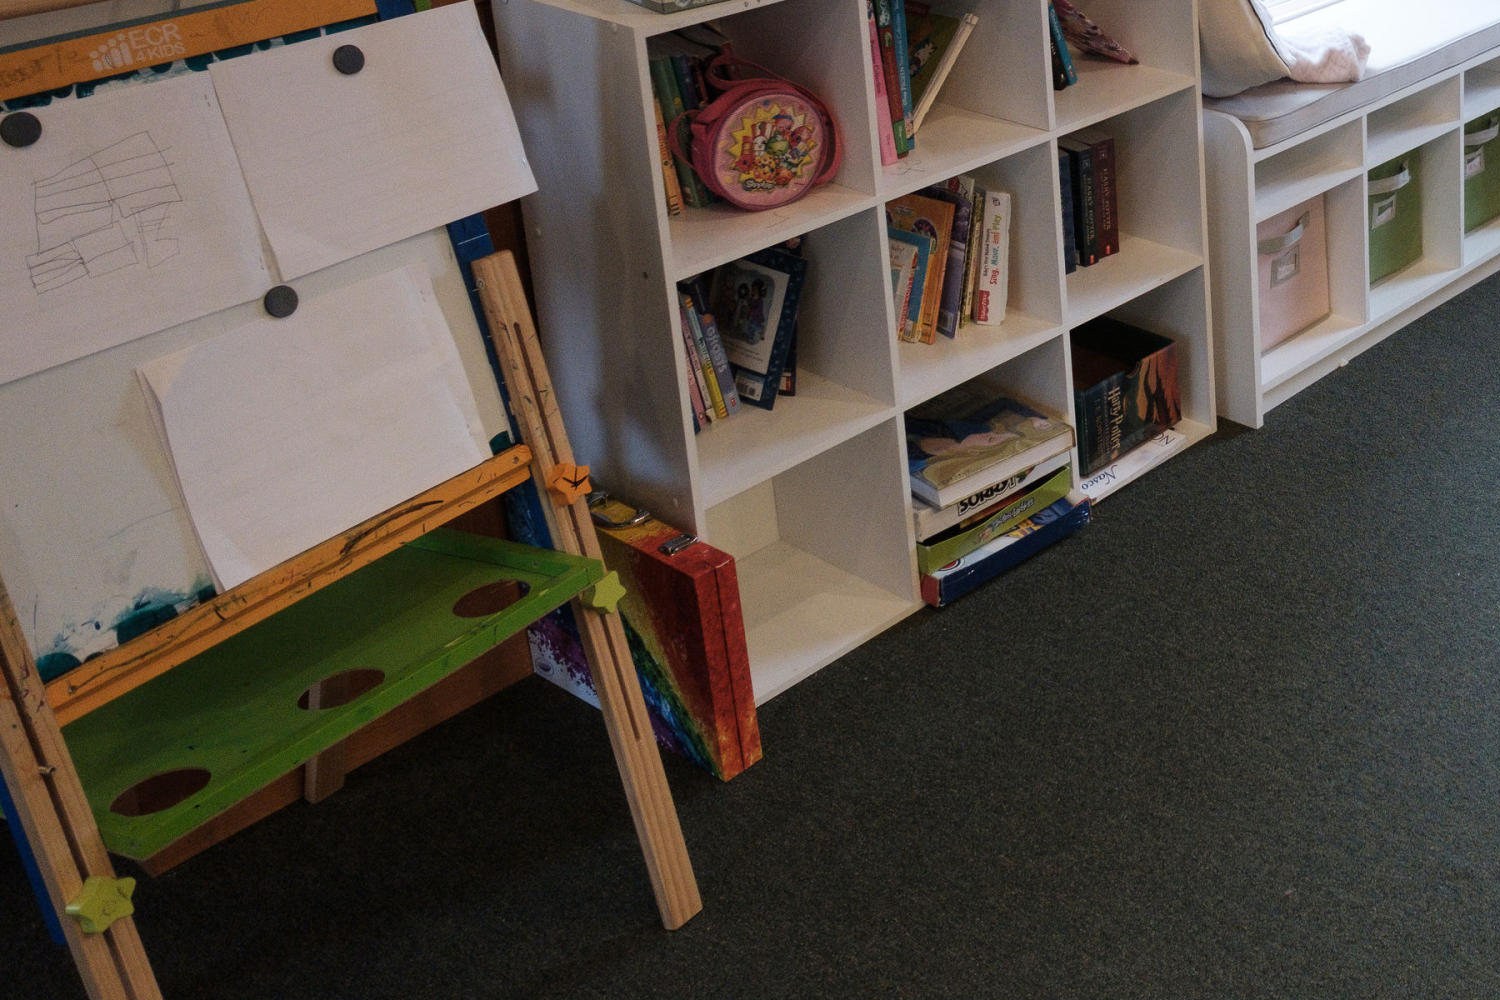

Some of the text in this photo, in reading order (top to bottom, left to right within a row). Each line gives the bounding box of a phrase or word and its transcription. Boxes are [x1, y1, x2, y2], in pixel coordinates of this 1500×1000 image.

[128, 22, 182, 49] ECR
[992, 214, 1002, 230] Play
[707, 326, 728, 373] GHOSTS
[1108, 387, 1124, 450] Harry Potter
[1081, 464, 1118, 490] Nasco
